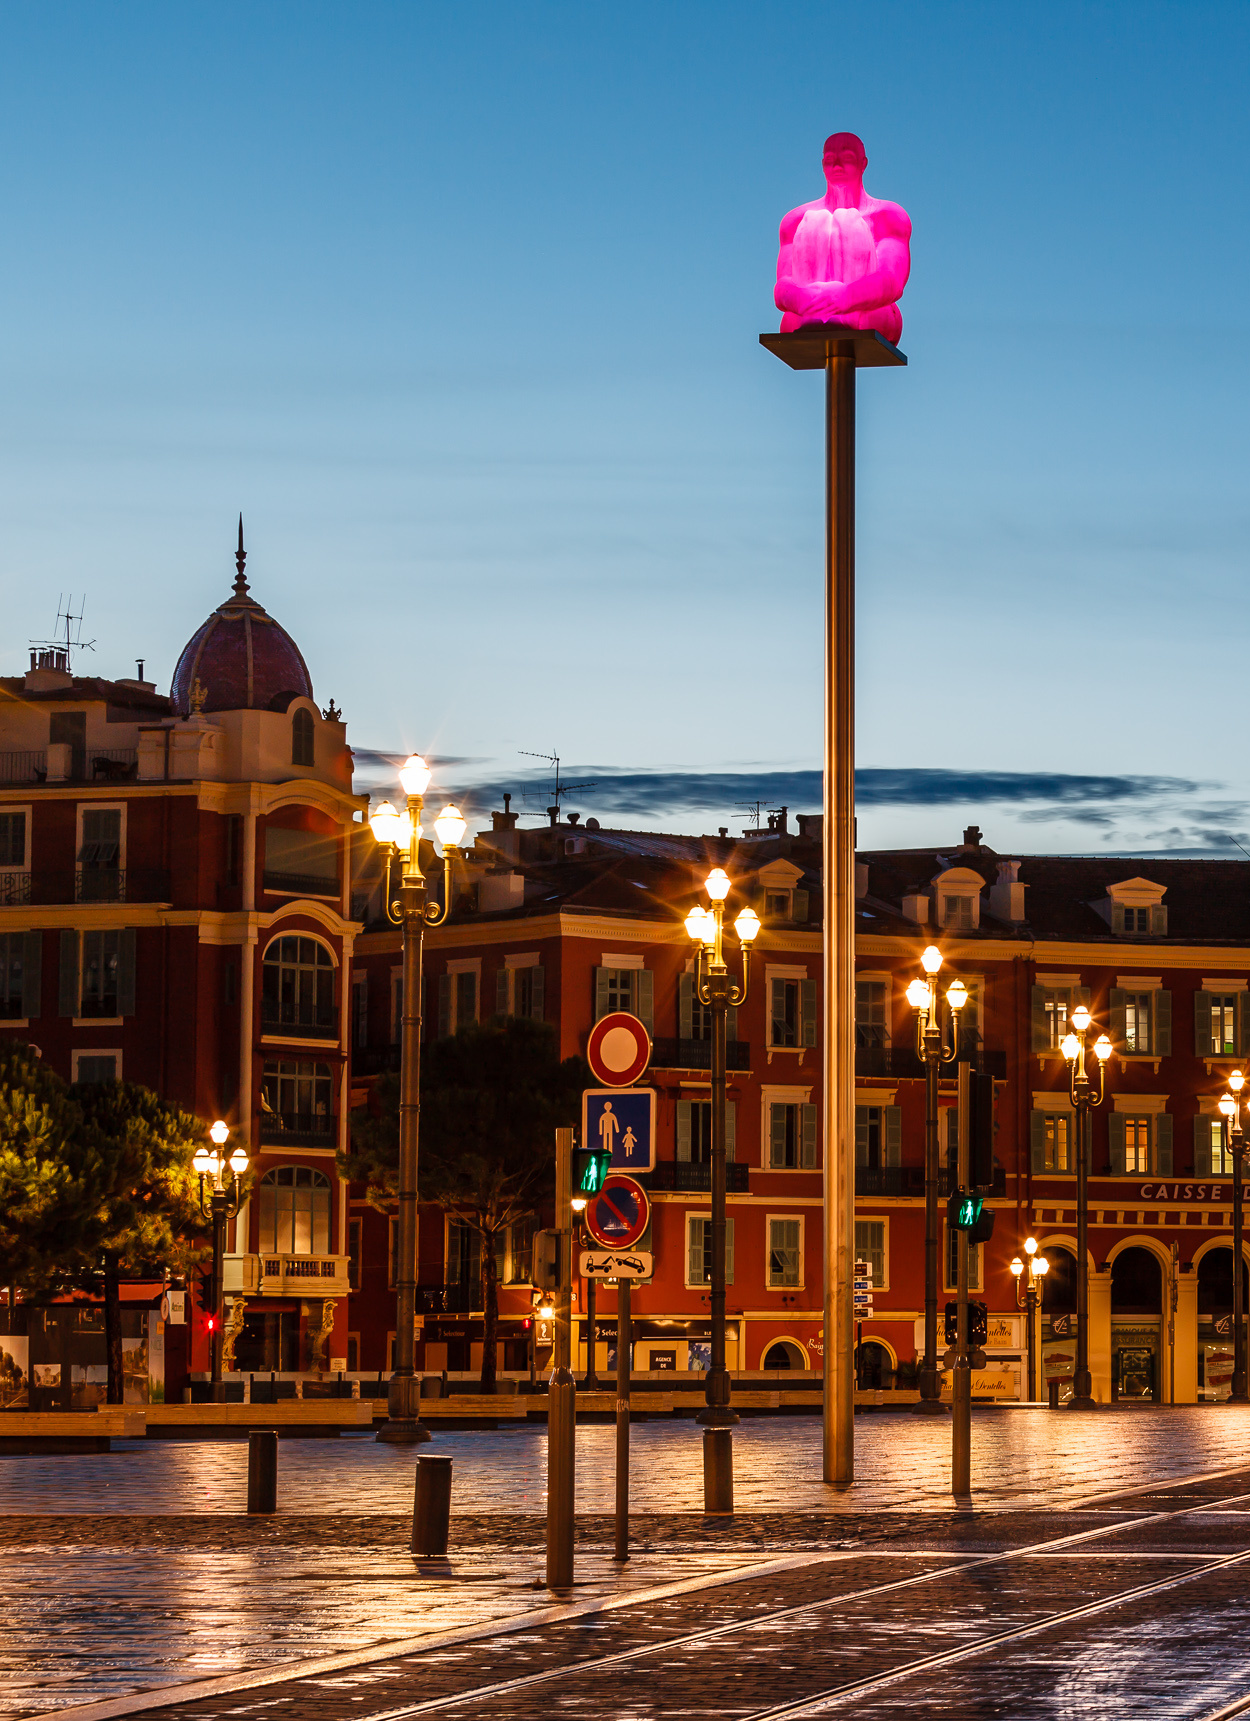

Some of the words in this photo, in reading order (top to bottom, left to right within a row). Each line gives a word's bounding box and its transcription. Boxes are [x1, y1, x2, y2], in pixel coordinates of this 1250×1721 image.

[1140, 1184, 1222, 1200] CAISSE
[602, 1329, 618, 1337] Selec
[974, 1379, 1006, 1390] Dentelles
